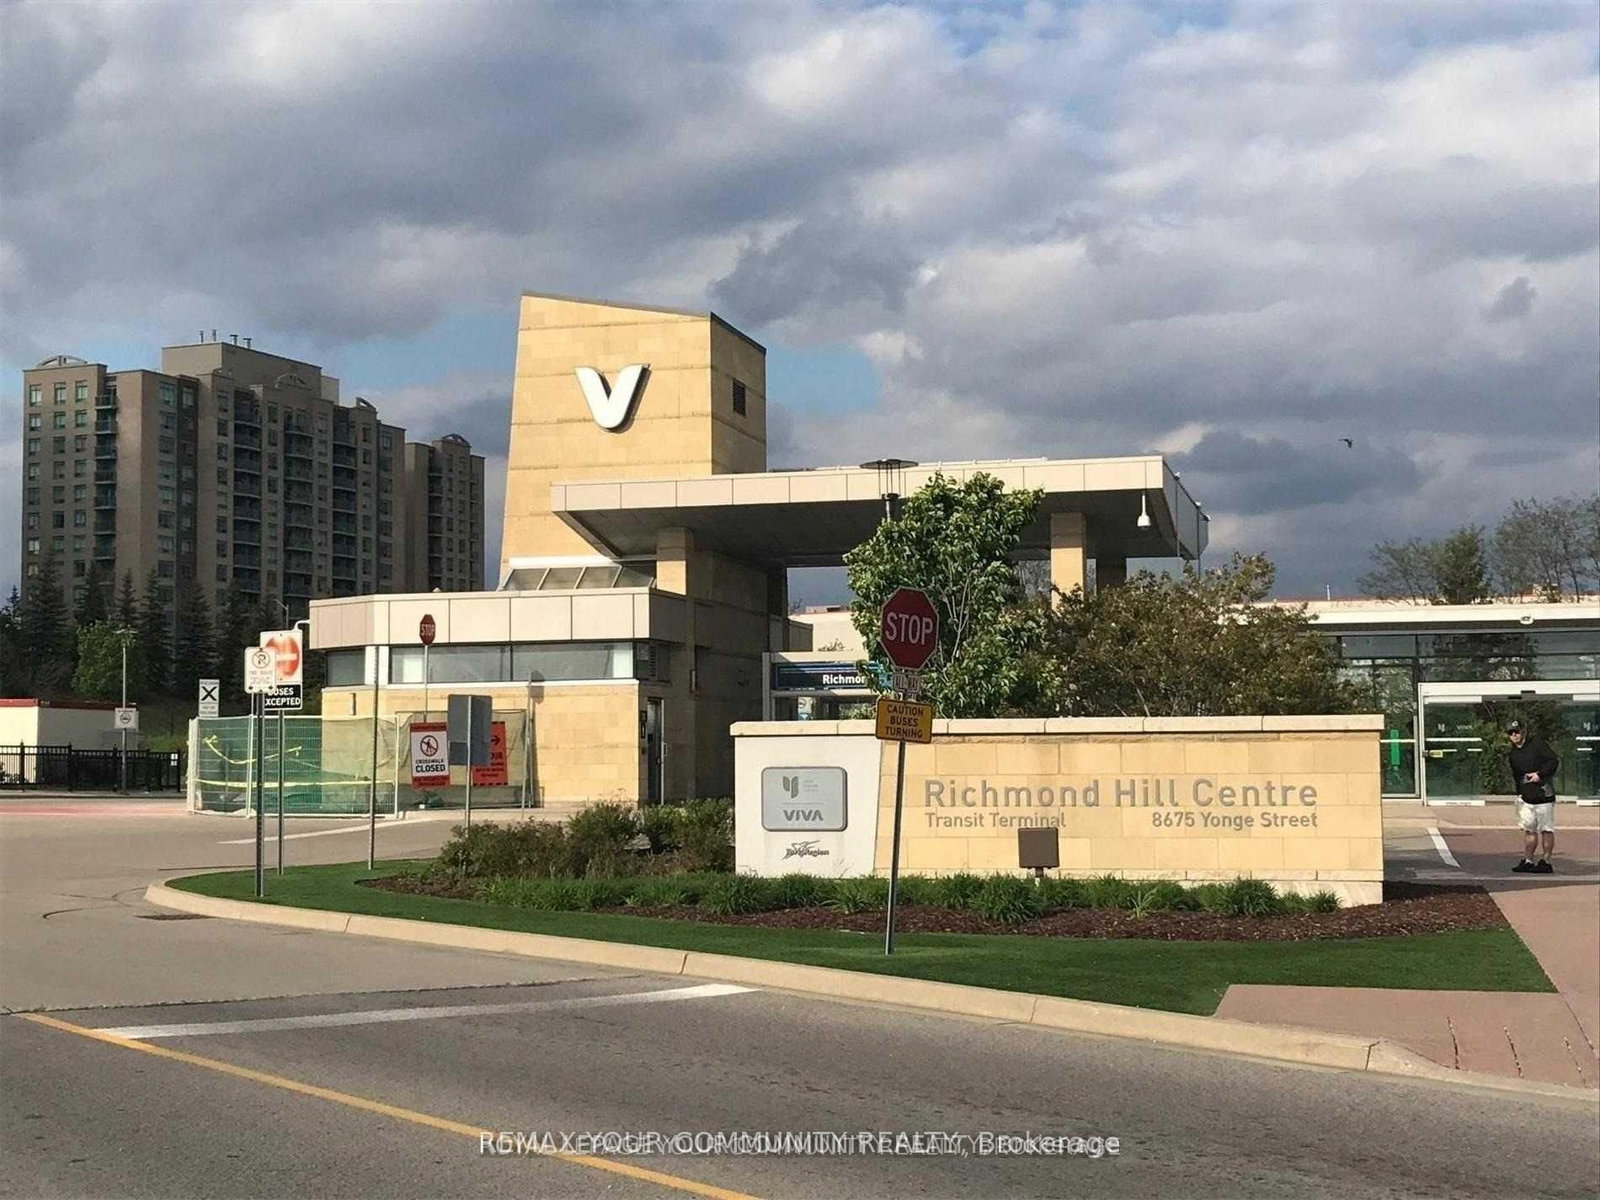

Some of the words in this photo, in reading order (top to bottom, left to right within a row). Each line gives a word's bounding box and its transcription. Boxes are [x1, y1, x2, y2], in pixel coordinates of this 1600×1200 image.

[885, 612, 933, 645] STOP
[887, 704, 924, 717] CAUTION
[890, 716, 919, 727] BUSES
[885, 726, 923, 738] TURNING
[415, 764, 446, 773] CLOSED
[924, 779, 1099, 807] Richmond
[1114, 779, 1179, 807] Hill
[1191, 779, 1318, 807] Centre
[783, 809, 824, 821] VIVA
[925, 812, 984, 828] Transit
[989, 812, 1067, 828] Terminal
[1152, 811, 1195, 827] 8675
[1200, 812, 1254, 831] Yonge
[1260, 811, 1318, 828] Street
